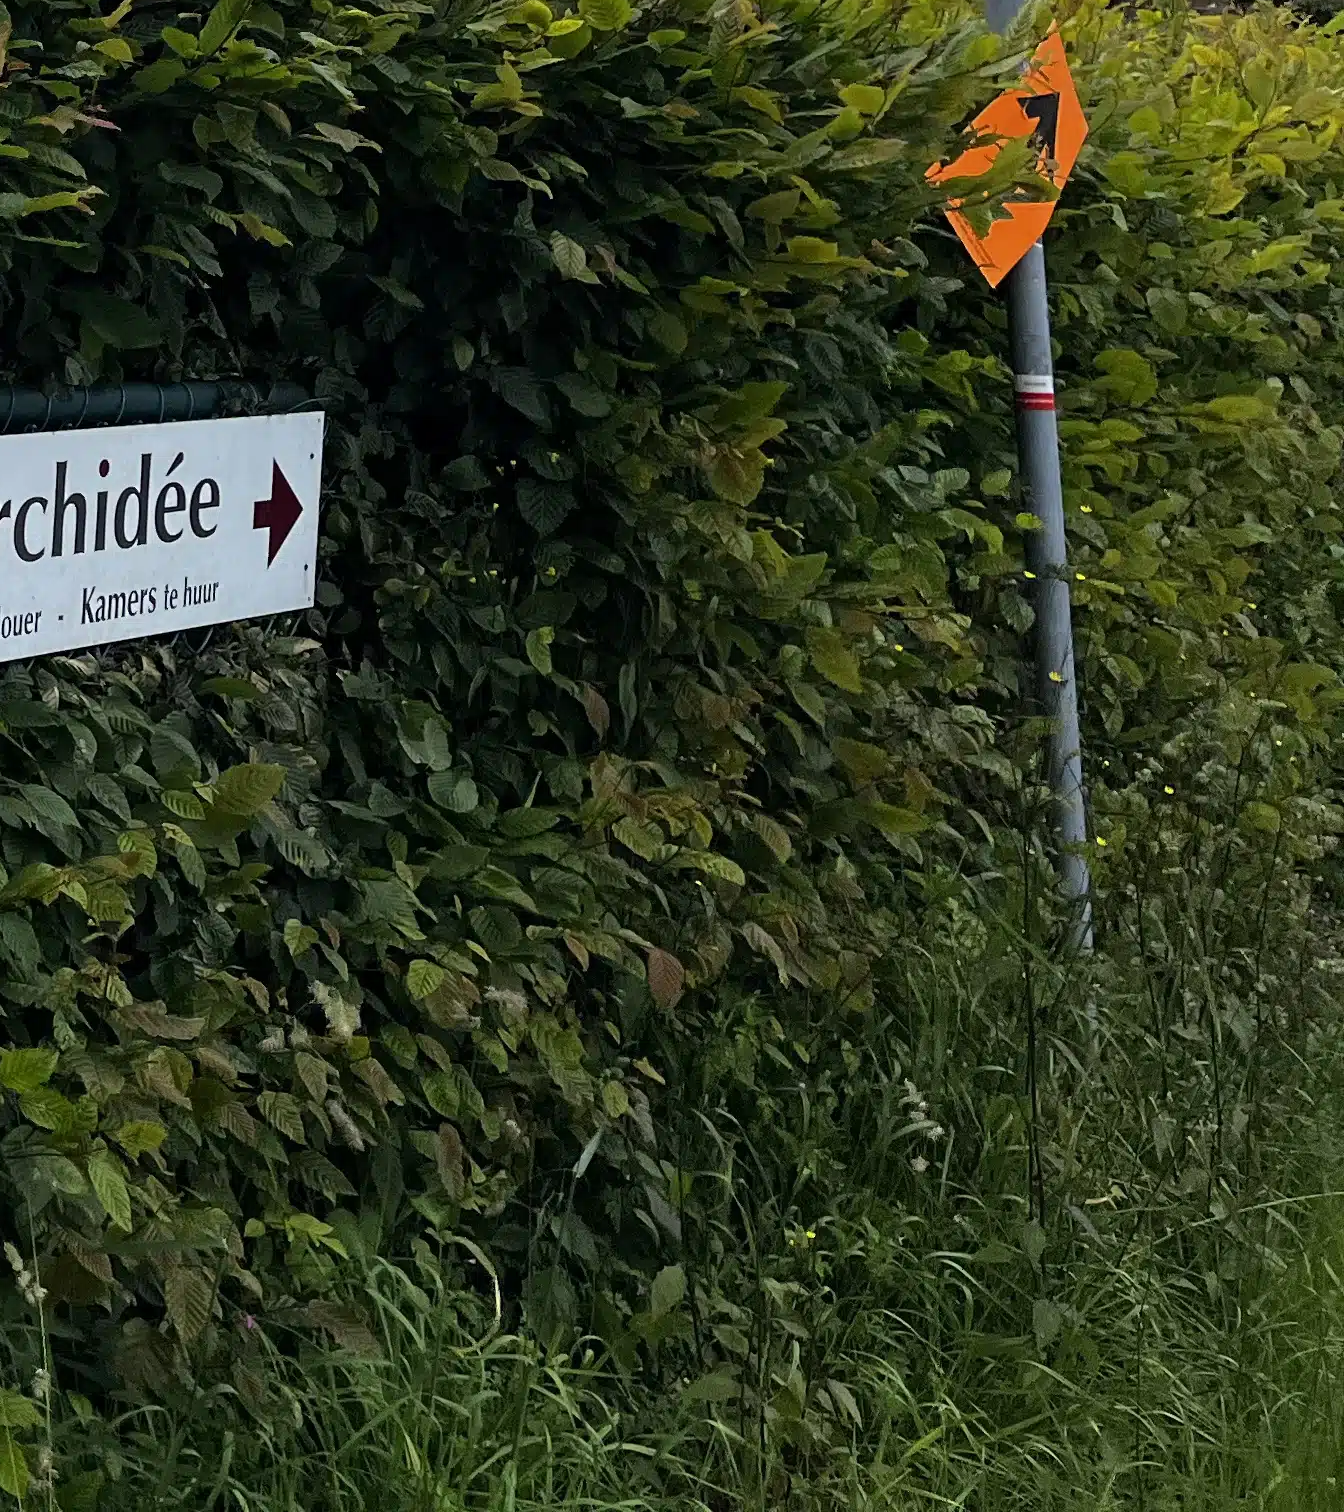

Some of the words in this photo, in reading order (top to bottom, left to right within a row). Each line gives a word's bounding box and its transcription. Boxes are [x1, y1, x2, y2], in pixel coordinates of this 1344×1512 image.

[80, 585, 157, 625] Kamers
[163, 583, 179, 611] te
[182, 576, 220, 608] huur
